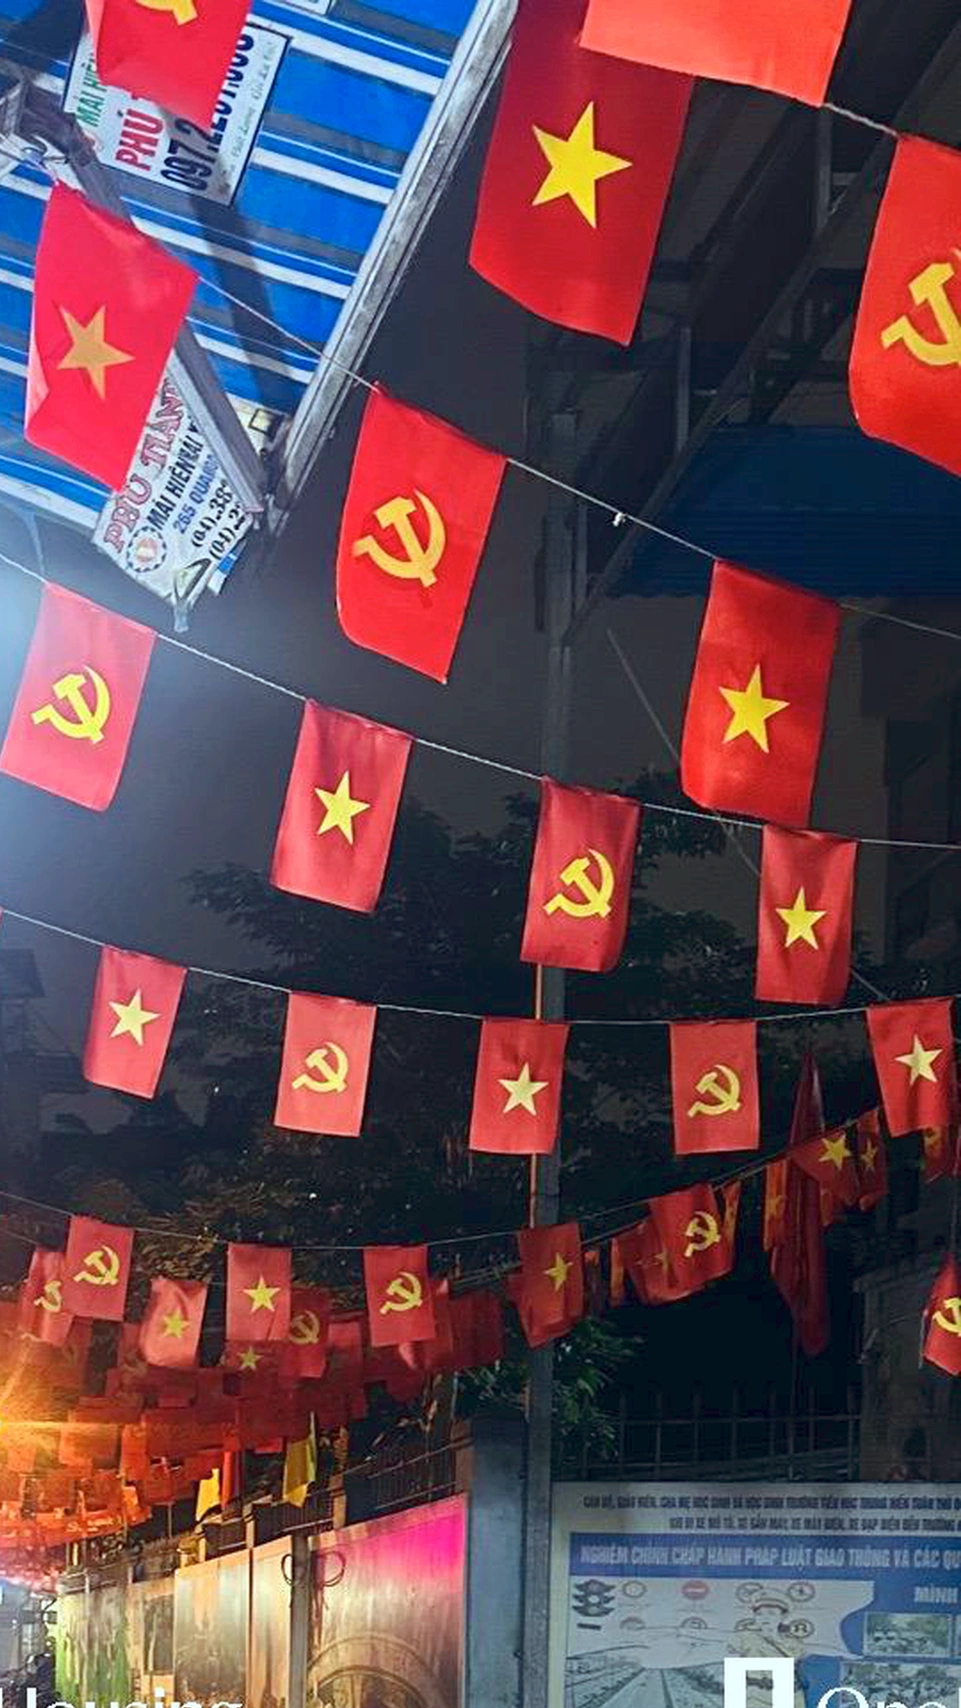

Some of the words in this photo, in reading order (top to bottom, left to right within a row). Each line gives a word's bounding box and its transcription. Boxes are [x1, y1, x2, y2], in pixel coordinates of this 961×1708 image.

[115, 107, 164, 171] PHÚ
[173, 504, 198, 534] 265
[210, 503, 246, 559] (04).2
